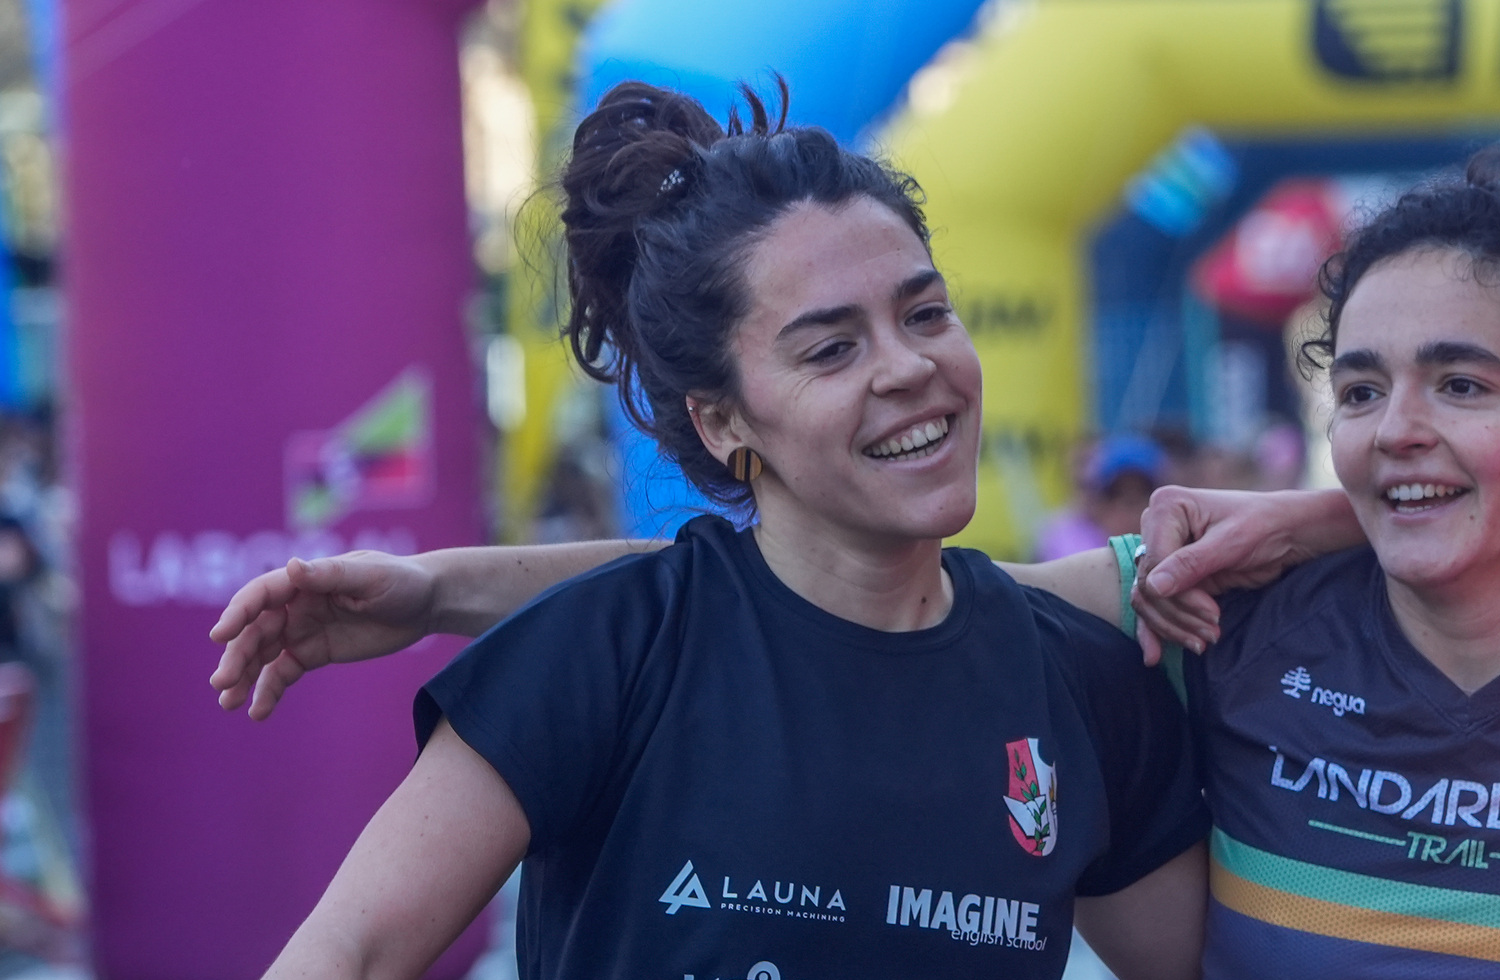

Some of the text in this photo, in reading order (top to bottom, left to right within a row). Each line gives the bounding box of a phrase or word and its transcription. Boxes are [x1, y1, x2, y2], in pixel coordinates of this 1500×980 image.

[1310, 685, 1367, 718] negua
[1405, 830, 1490, 870] TRAIL
[720, 876, 847, 912] LAUNA
[720, 902, 847, 924] PRECISION MACHINING
[885, 884, 1041, 942] IMAGINE
[950, 926, 1048, 952] english school
